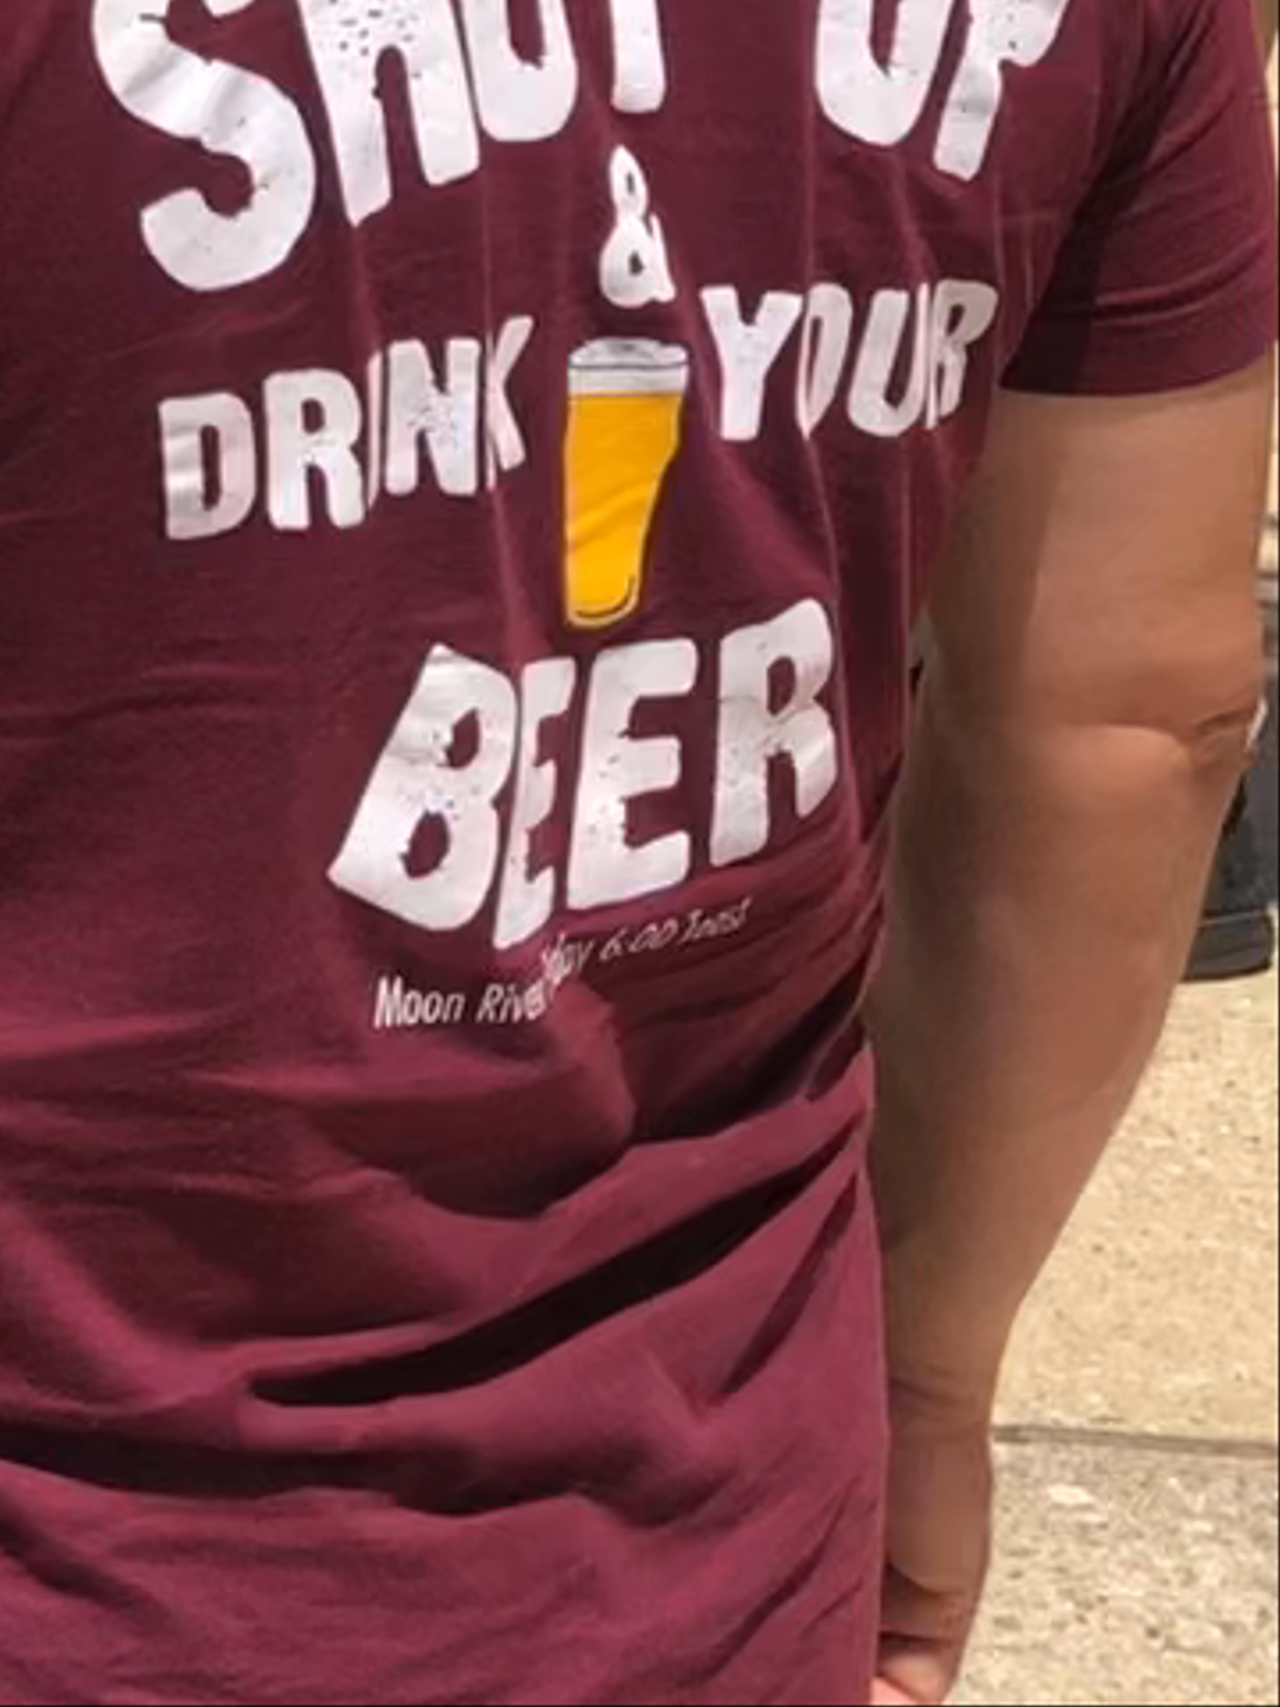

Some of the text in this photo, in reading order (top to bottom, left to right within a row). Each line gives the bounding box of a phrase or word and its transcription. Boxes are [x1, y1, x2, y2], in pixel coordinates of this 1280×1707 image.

[598, 144, 676, 308] &
[157, 278, 998, 541] DRINK YOUR
[326, 597, 839, 950] BEER
[374, 976, 465, 1029] Moon
